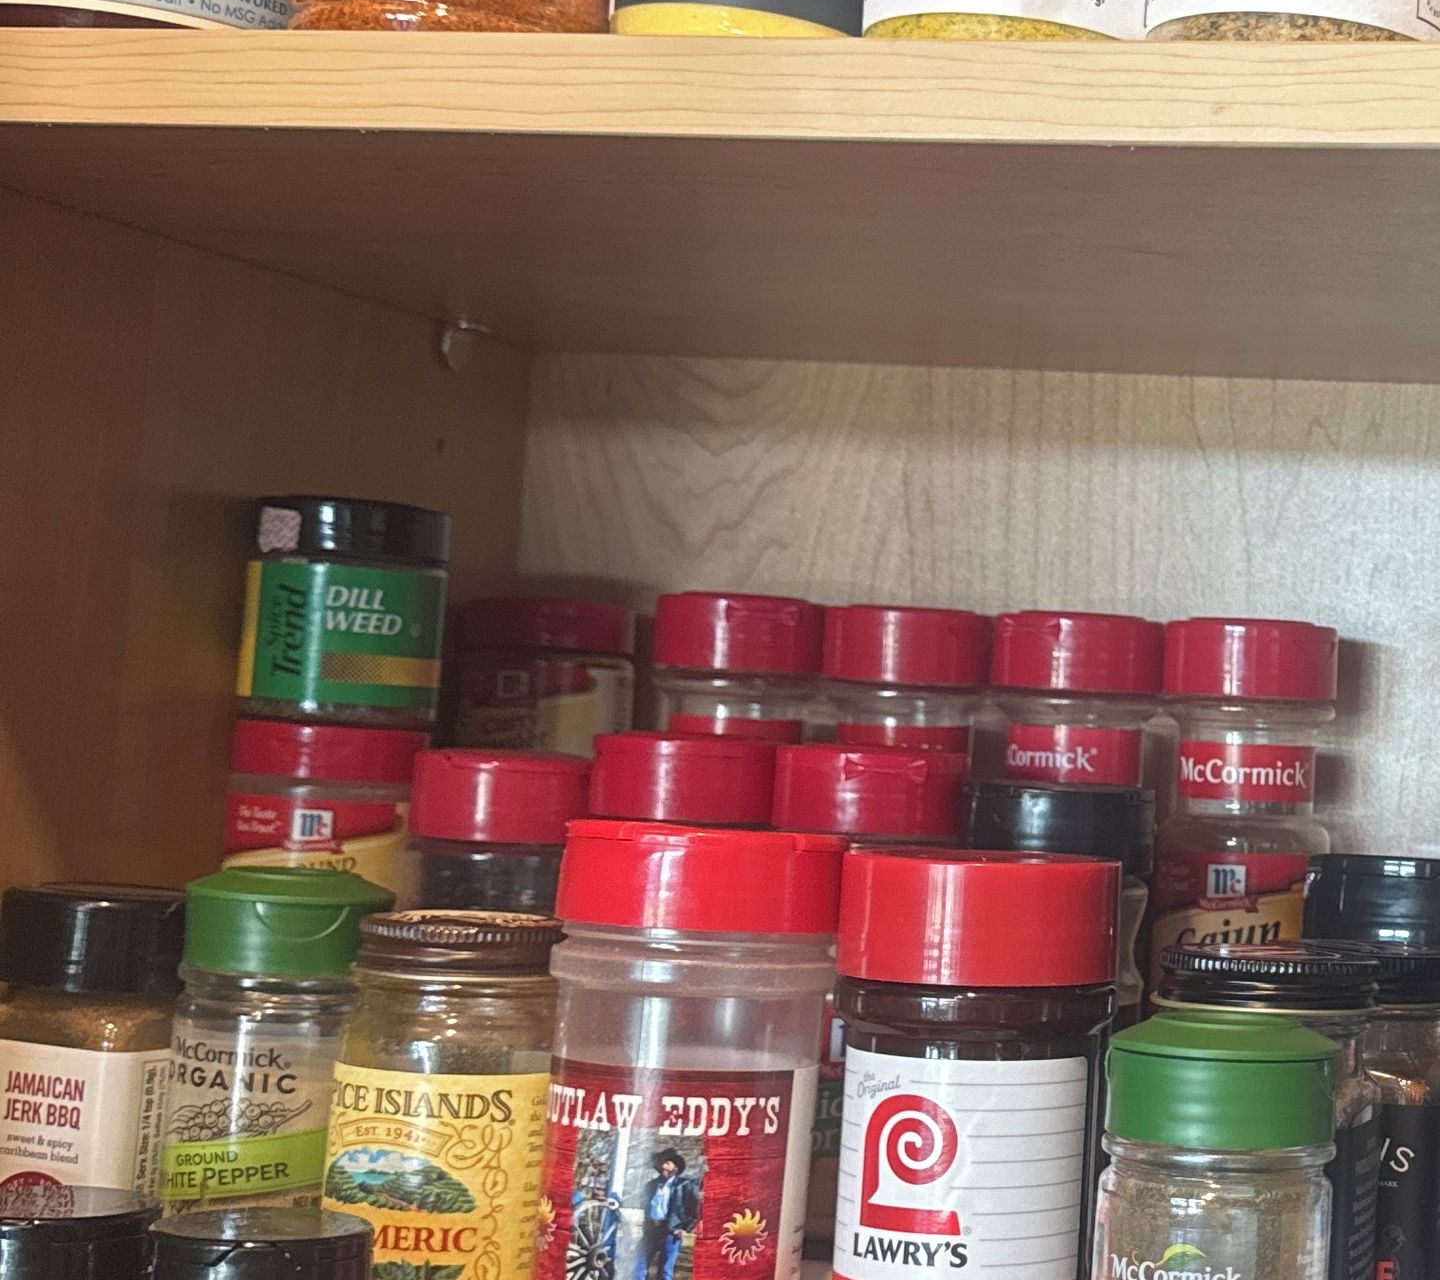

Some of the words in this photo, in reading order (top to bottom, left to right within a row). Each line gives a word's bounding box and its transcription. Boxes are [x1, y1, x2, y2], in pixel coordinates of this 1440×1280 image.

[325, 584, 386, 612] DILL
[324, 610, 402, 636] WEED
[1180, 753, 1306, 790] McCormick
[5, 1071, 85, 1102] JAMAICAN
[4, 1098, 43, 1124] JERK
[46, 1104, 81, 1131] BBQ
[374, 1088, 513, 1123] ISLANDS
[659, 1095, 780, 1137] EDDY'S
[177, 1150, 238, 1166] GROUND
[204, 1162, 289, 1186] PEPPER
[853, 1232, 968, 1269] LAWRY'S
